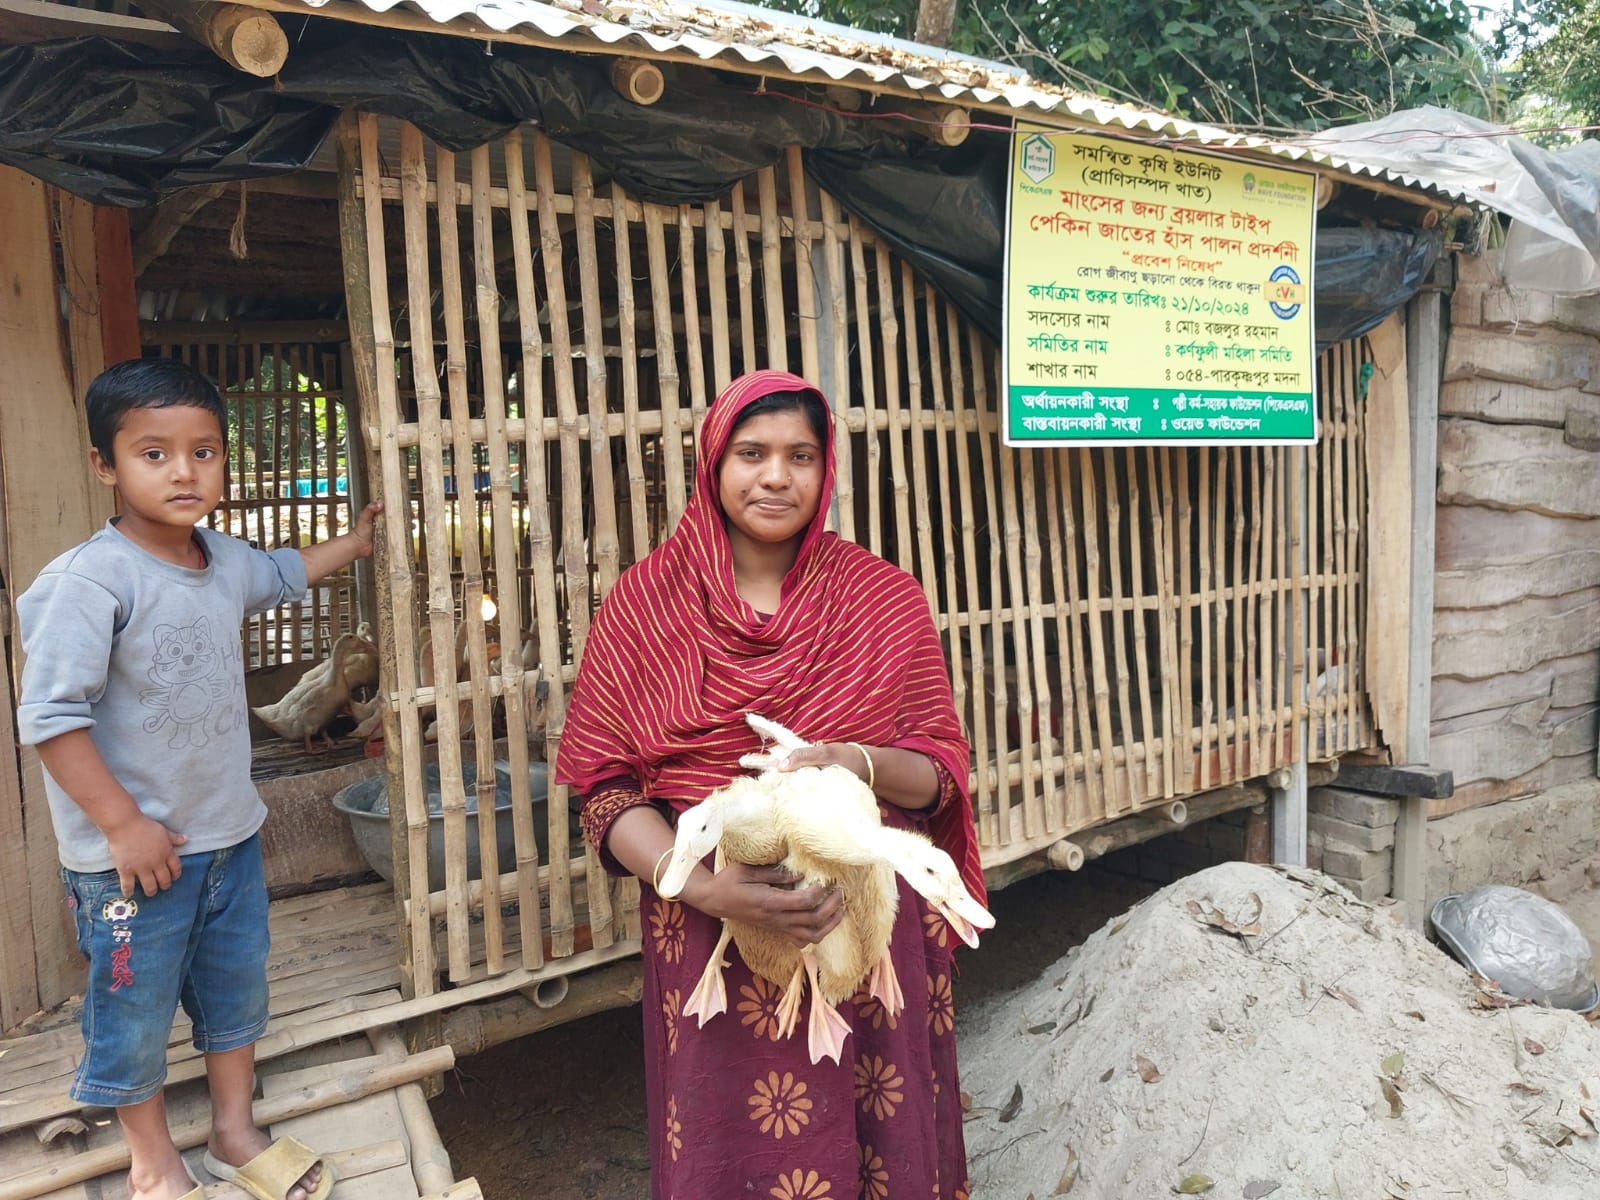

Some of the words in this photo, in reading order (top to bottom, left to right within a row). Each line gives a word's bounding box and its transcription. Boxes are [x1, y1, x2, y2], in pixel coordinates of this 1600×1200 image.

[1072, 144, 1134, 165] সমন্বিত
[1138, 154, 1168, 175] কৃষি
[1173, 158, 1223, 181] ইউনিট
[1082, 166, 1170, 194] (প্রাণিসম্পদ
[1176, 182, 1212, 203] খাত)
[1060, 190, 1125, 214] মাংসের
[1131, 200, 1167, 221] জন্য
[1171, 207, 1225, 228] ব্রয়লার
[1230, 209, 1271, 235] টাইপ
[1031, 211, 1091, 237] পেকিন
[1098, 222, 1156, 245] জাতের
[1162, 226, 1194, 249] হাঁস
[1200, 236, 1243, 255] পালন
[1248, 240, 1300, 262] প্রদর্শনী
[1077, 266, 1101, 278] রোগ
[1106, 265, 1137, 284] জীবাণু
[1180, 276, 1204, 287] থেকে
[1208, 275, 1232, 289] বিরত
[1027, 281, 1080, 303] কার্যক্রম
[1085, 289, 1118, 304] শুরুর
[1172, 295, 1249, 316] ২১/১০/২০২৪
[1027, 310, 1082, 328] সদস্যের
[1085, 313, 1111, 329] নাম
[1203, 322, 1240, 340] বজলুর
[1244, 325, 1279, 340] রহমান
[1027, 332, 1079, 352] সমিতির
[1083, 340, 1109, 354] নাম
[1174, 340, 1218, 362] কর্ণফুলী
[1222, 343, 1256, 362] মহিলা
[1259, 345, 1293, 362] সমিতি
[1026, 362, 1068, 378] শাখার
[1072, 364, 1098, 379] নাম
[1273, 372, 1300, 385] মদনা
[1021, 390, 1095, 410] অর্থায়নকারী
[1098, 395, 1129, 412] সংস্থা
[1021, 412, 1107, 431] বাস্তবায়নকারী
[1110, 416, 1142, 433] সংস্থা
[1171, 418, 1204, 431] ওয়েভ
[1206, 414, 1261, 431] ফাউন্ডেশন
